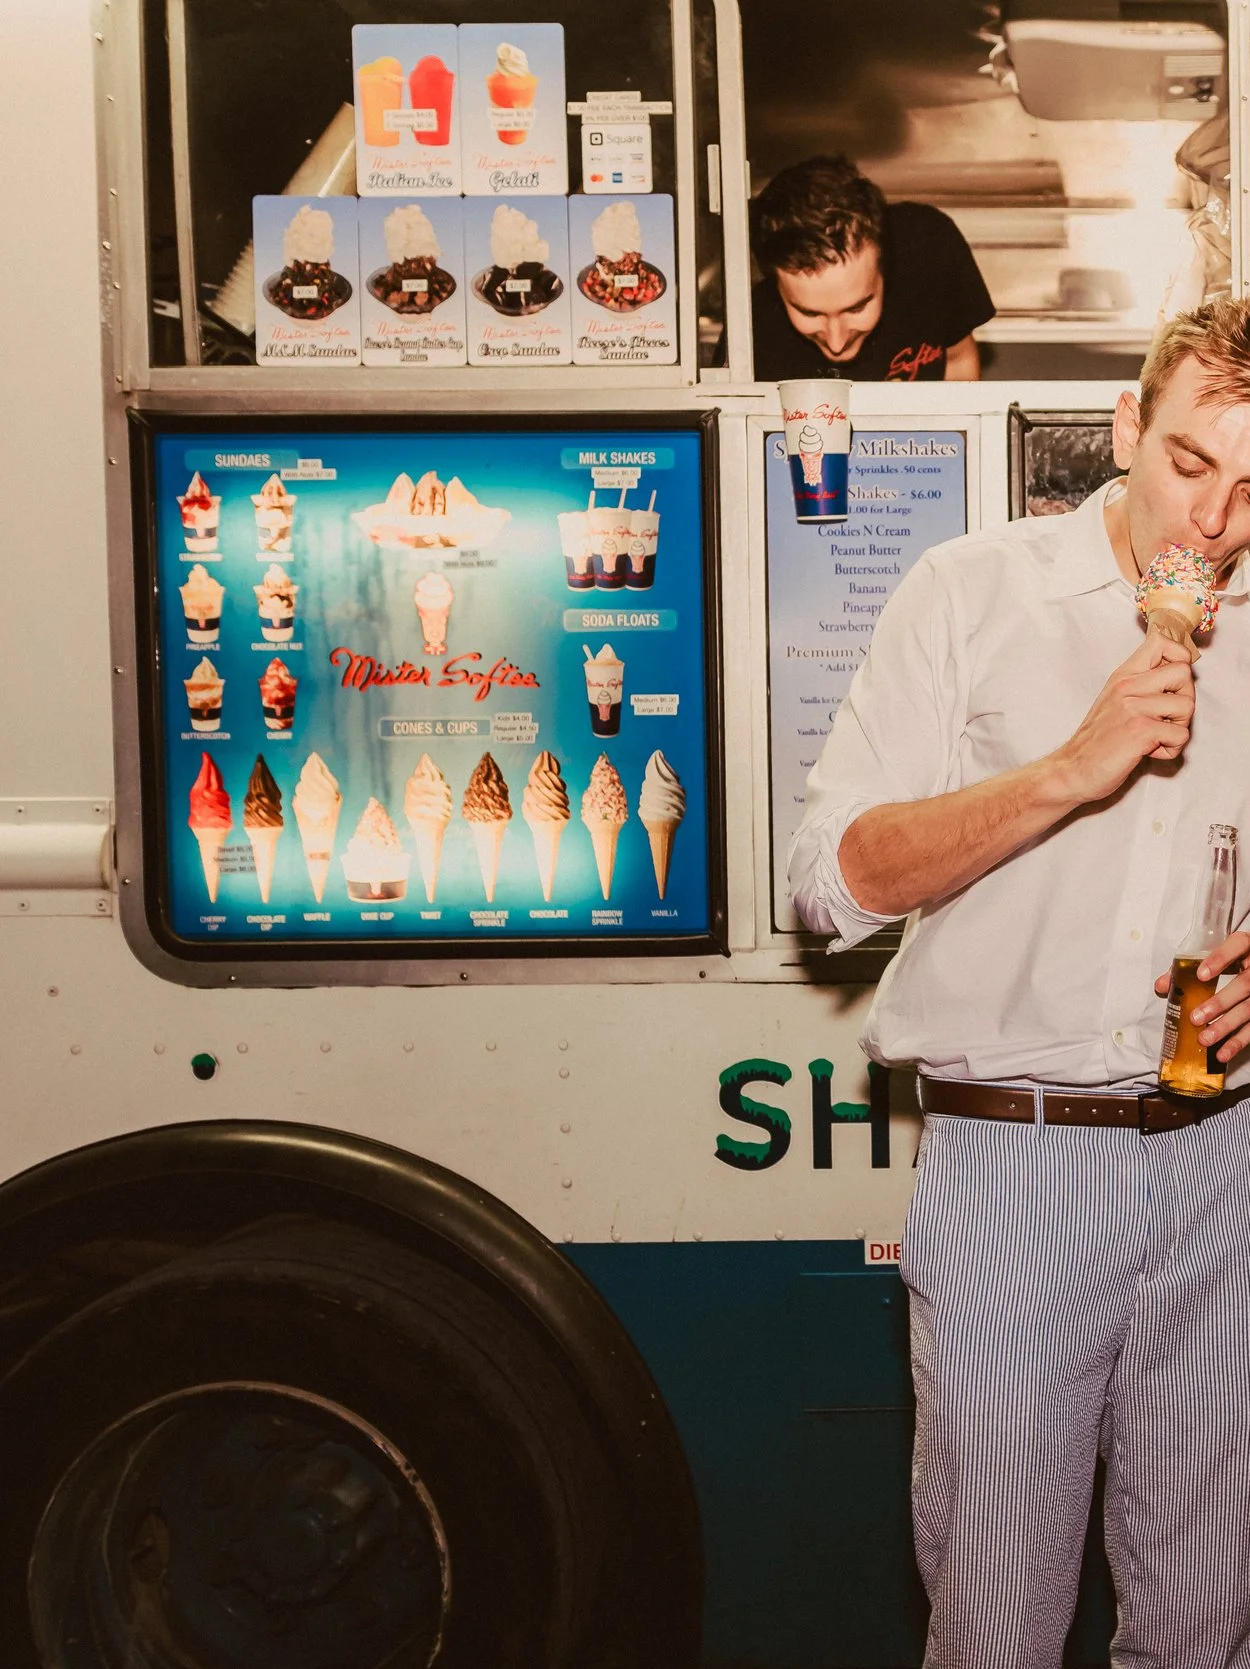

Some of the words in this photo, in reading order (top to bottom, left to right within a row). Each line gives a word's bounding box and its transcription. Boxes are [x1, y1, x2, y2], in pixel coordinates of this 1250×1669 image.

[606, 133, 644, 145] Square
[488, 170, 540, 193] Gelati
[858, 438, 957, 456] Milkshakes
[214, 454, 271, 467] SUNDAES
[579, 452, 607, 465] MILK
[610, 452, 656, 465] SHAKES
[854, 465, 898, 476] Sprinkles
[917, 466, 942, 474] cents
[910, 490, 942, 500] $6.00
[870, 505, 884, 514] for
[886, 505, 912, 516] Large
[817, 525, 861, 538] Cookies
[863, 525, 873, 537] N
[875, 525, 911, 537] Cream
[830, 544, 866, 556] Peanut
[869, 544, 902, 556] Butter
[834, 562, 901, 575] Butterscotch
[849, 582, 887, 594] Banana
[582, 614, 614, 627] SODA
[616, 614, 660, 627] FLOATS
[818, 620, 875, 636] Strawberry
[786, 645, 854, 658] Premium
[329, 646, 432, 693] Mister
[438, 651, 542, 703] Softee
[393, 722, 433, 735] CONES
[435, 722, 446, 734] &
[447, 721, 478, 734] CUPS
[470, 910, 509, 920] CHOCOLATE
[529, 909, 569, 919] CHOCOLATE
[591, 909, 623, 918] RAINBOW
[651, 909, 679, 918] VANILLA
[591, 917, 623, 926] SPRINKLE
[714, 1057, 917, 1172] SH
[870, 1243, 901, 1260] DIE
